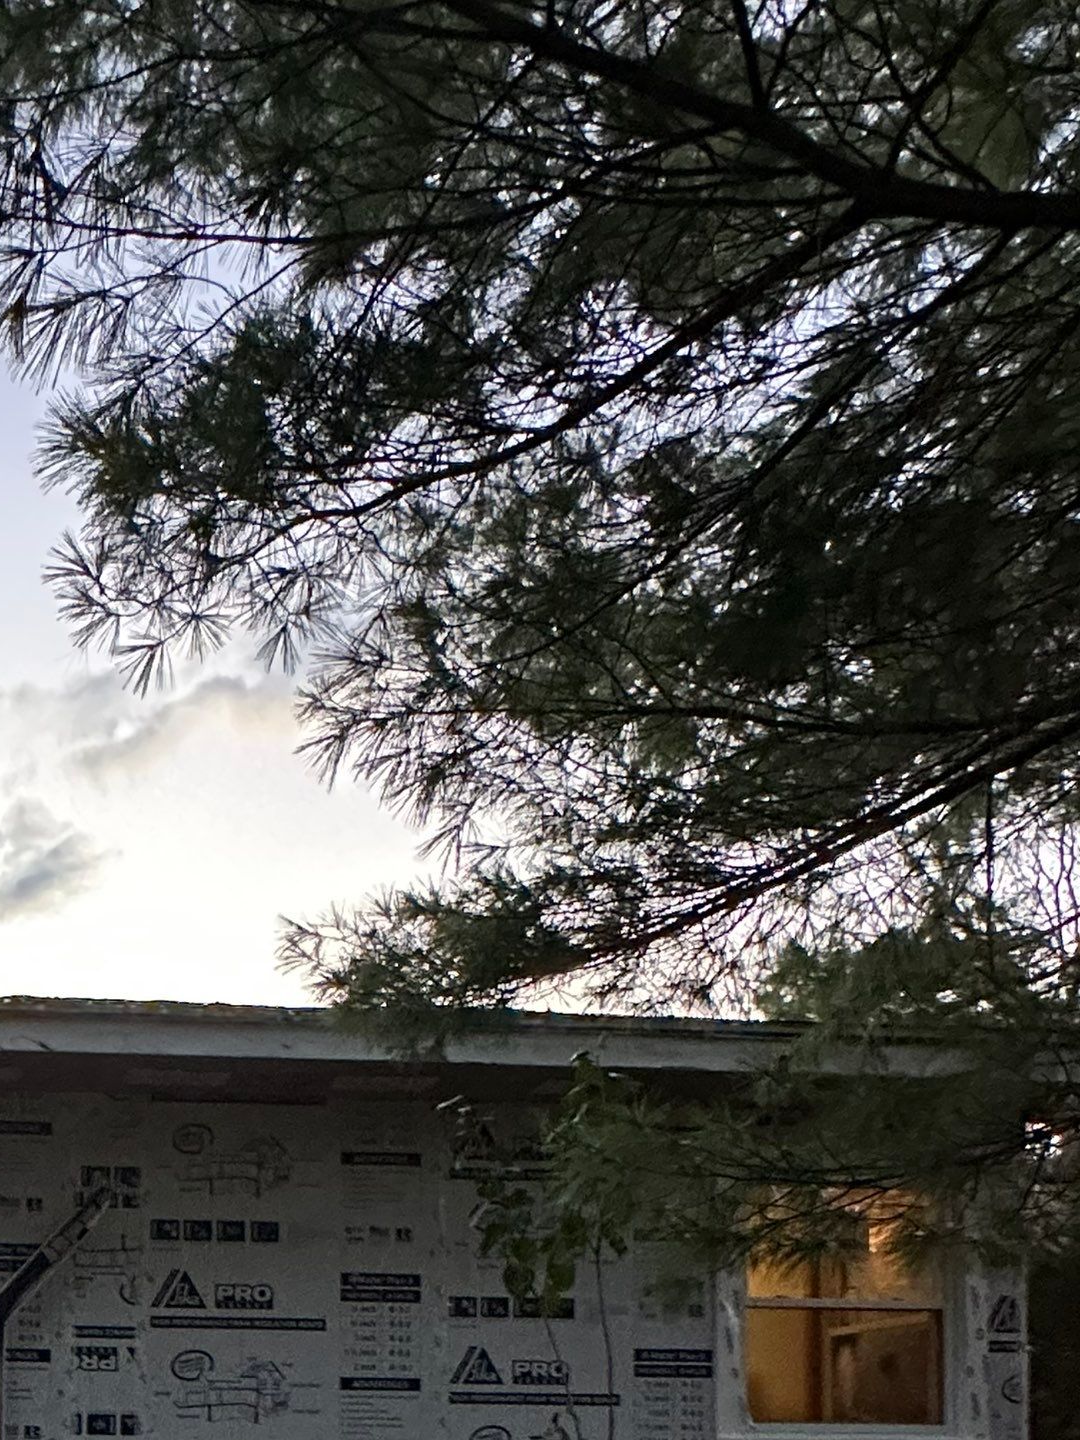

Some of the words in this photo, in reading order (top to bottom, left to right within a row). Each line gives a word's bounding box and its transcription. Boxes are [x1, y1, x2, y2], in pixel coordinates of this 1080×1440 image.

[216, 1285, 273, 1302] PRO
[71, 1355, 116, 1370] PR
[513, 1361, 568, 1378] PRO
